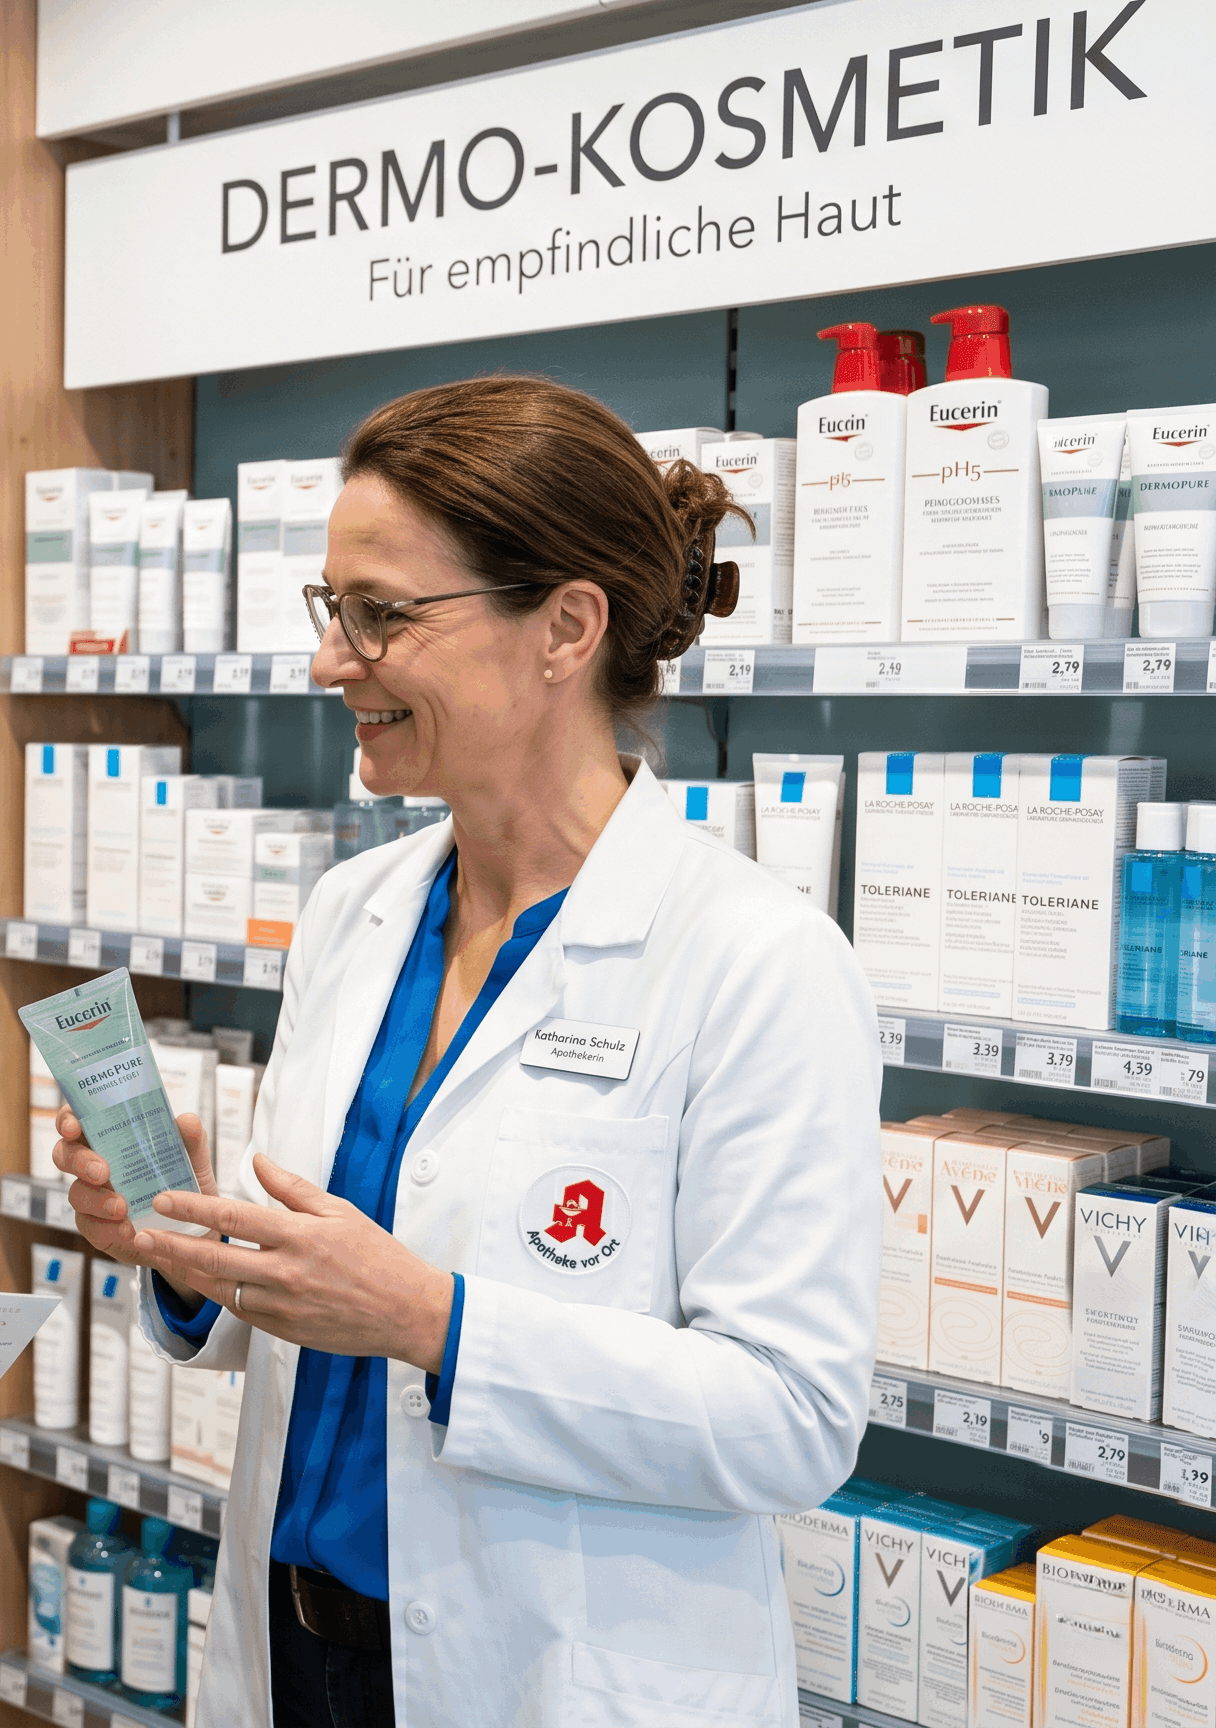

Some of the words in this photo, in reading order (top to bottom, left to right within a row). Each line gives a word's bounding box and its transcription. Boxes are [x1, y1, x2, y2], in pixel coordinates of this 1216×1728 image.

[222, 0, 1148, 254] DERMO-KOSMETIK
[369, 256, 433, 301] Für
[447, 205, 755, 295] empfindliche
[777, 184, 902, 243] Haut
[929, 401, 999, 422] Eucerin
[1152, 425, 1208, 440] Eucerin
[715, 453, 757, 468] Eucerin
[941, 460, 982, 484] pH5
[1140, 479, 1210, 491] DERMOPURE
[729, 664, 751, 677] 2,19
[1051, 660, 1080, 677] 2,79
[1142, 659, 1172, 674] 2,79
[961, 803, 1018, 813] ROCHE-POSA
[1039, 807, 1104, 818] ROCHE-POSAY
[861, 884, 931, 899] TOLERIANE
[946, 889, 1017, 904] TOLERIANE
[1022, 895, 1100, 910] TOLERIANE
[534, 1029, 587, 1046] Katharina
[589, 1036, 626, 1051] Schulz
[550, 1047, 605, 1063] Apothekerin
[1123, 1060, 1153, 1076] 4,39
[1080, 1207, 1147, 1234] VICHY
[526, 1230, 577, 1269] Apotheke
[580, 1253, 600, 1269] vor
[601, 1238, 621, 1257] Ort
[1097, 1445, 1126, 1462] 2,79
[864, 1528, 915, 1554] VICHY
[926, 1546, 966, 1569] VICH
